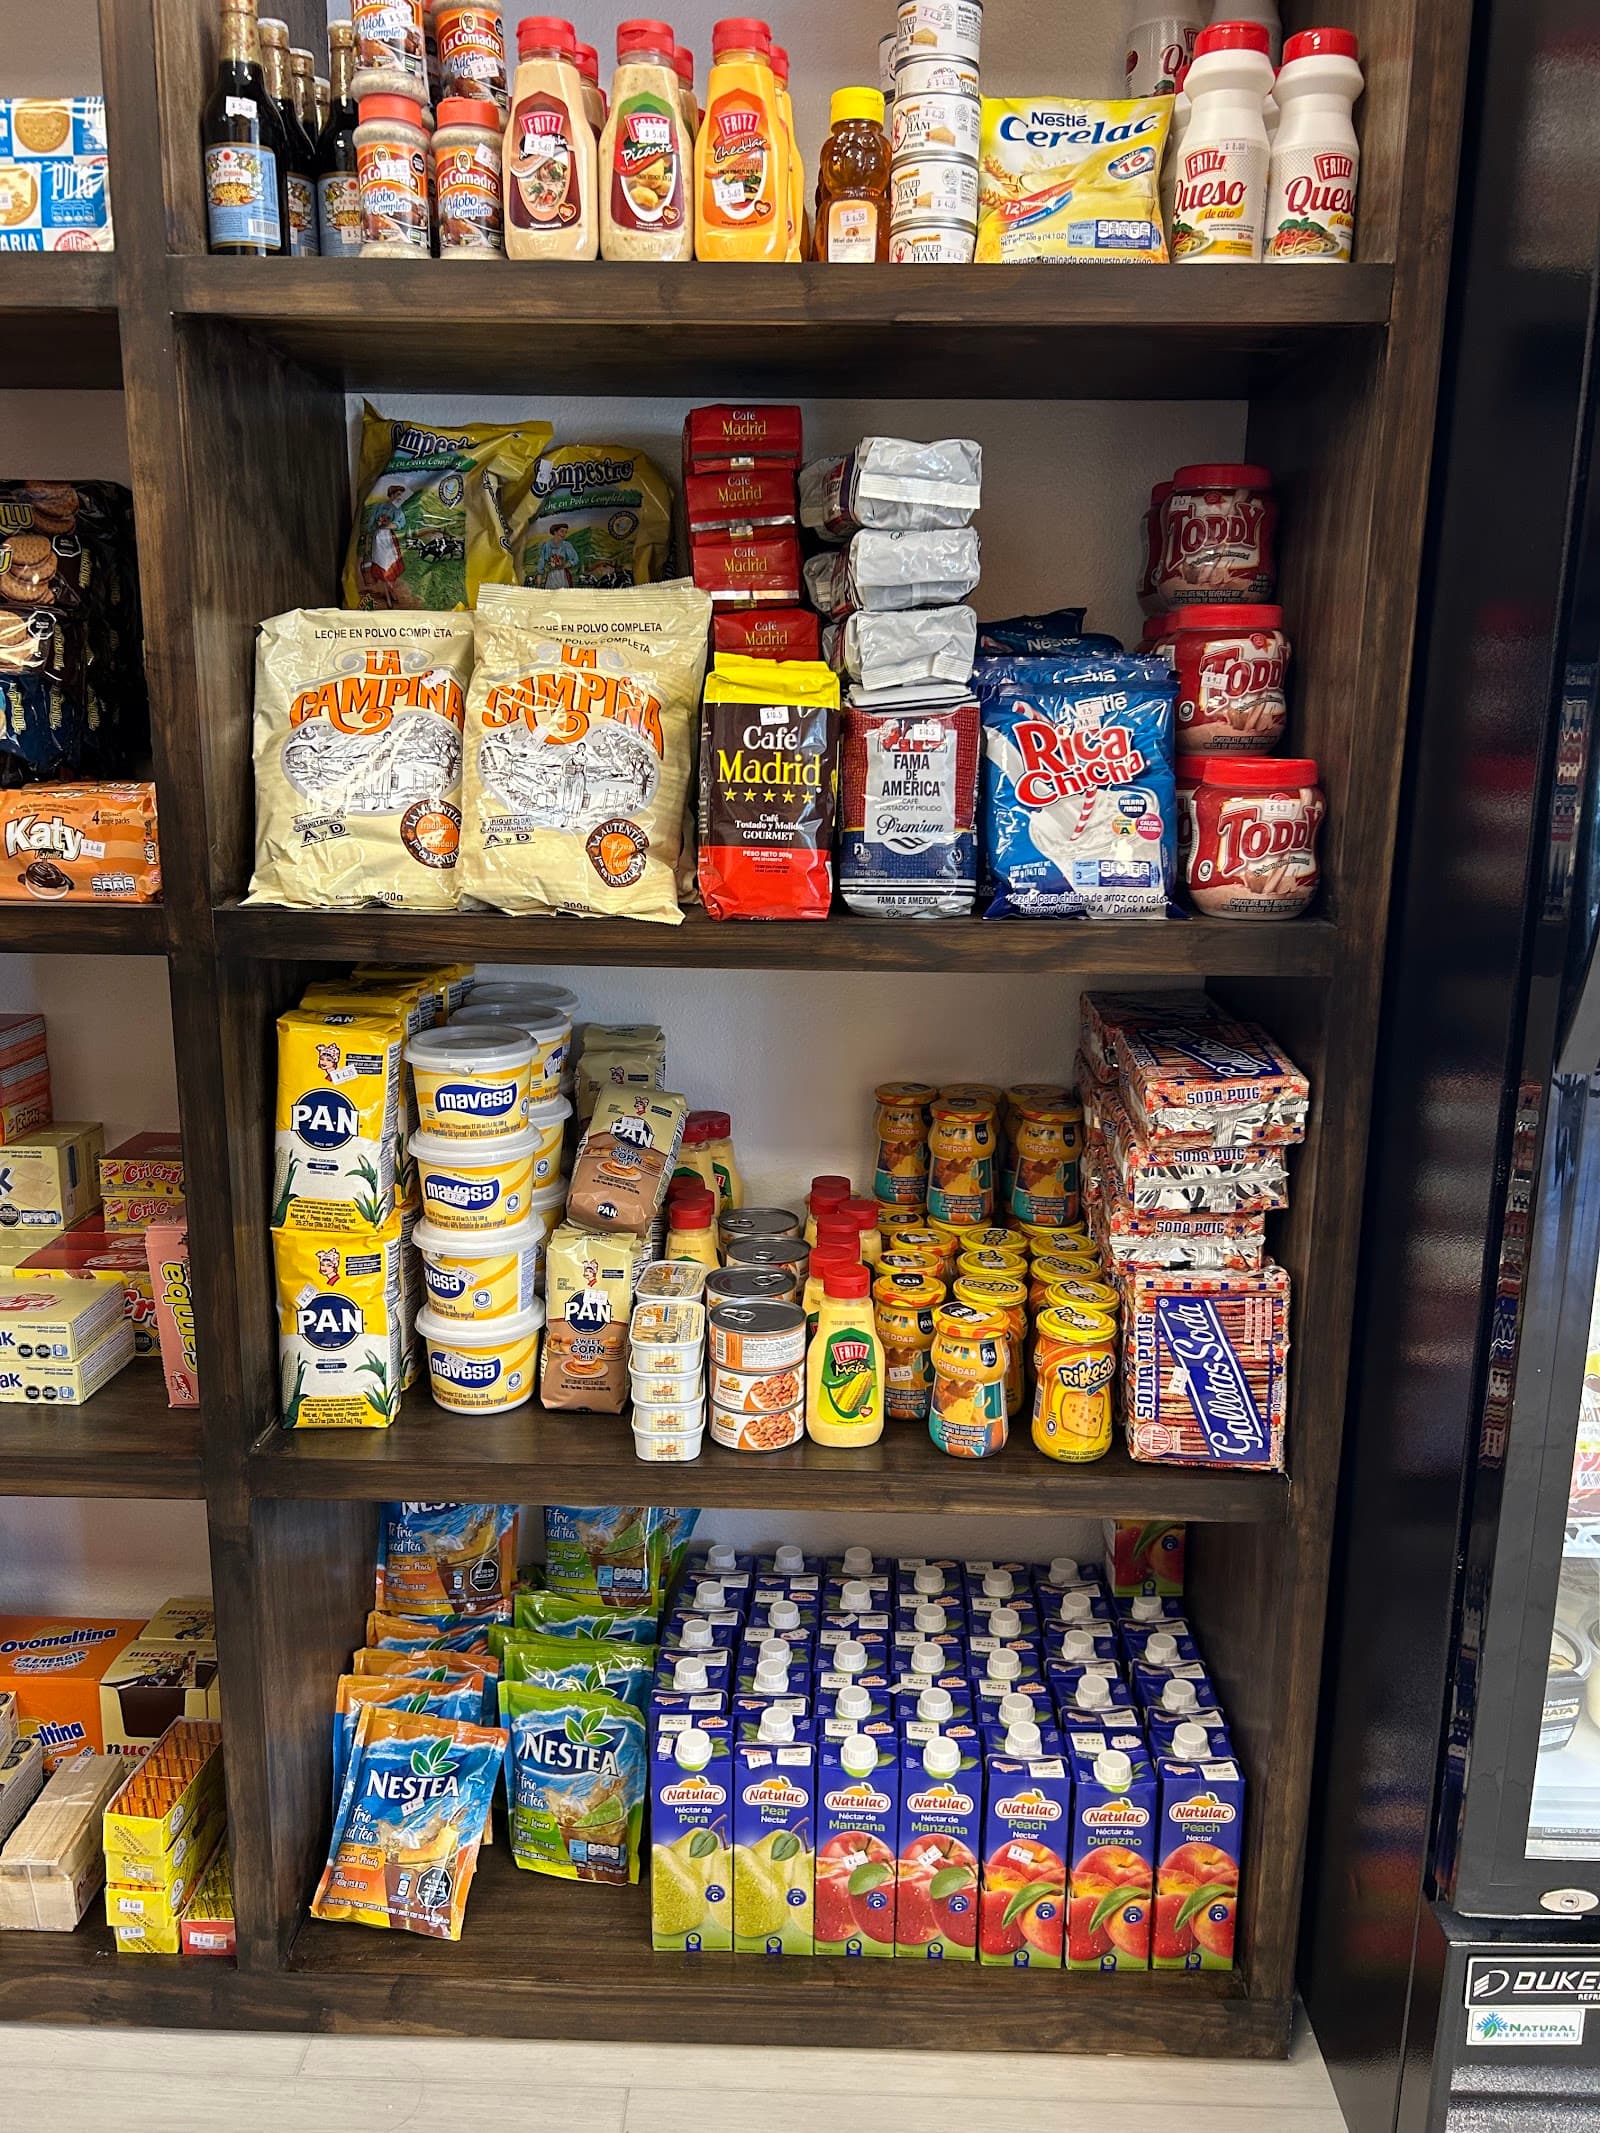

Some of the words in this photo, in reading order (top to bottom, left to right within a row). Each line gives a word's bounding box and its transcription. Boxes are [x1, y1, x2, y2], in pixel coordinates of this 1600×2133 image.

[444, 38, 454, 53] La
[455, 32, 500, 53] Comadre
[528, 114, 559, 134] FRITZ
[724, 113, 754, 135] FRITZ
[1031, 112, 1088, 127] Nestlé
[1000, 115, 1157, 148] Cerelac
[622, 143, 674, 167] Picante
[715, 137, 767, 163] Cheddar
[1190, 152, 1224, 176] FRITZ
[1322, 158, 1351, 178] FRITZ
[439, 175, 448, 192] La
[449, 170, 497, 193] Comadre
[365, 187, 396, 209] Adobo
[446, 192, 477, 211] Adobo
[373, 202, 410, 215] Completo
[454, 206, 492, 219] Completo
[1005, 203, 1019, 217] 12
[1205, 209, 1216, 218] de
[911, 245, 942, 254] DEVILED
[732, 410, 756, 421] Café
[722, 420, 767, 436] Madrid
[727, 476, 750, 487] Café
[718, 487, 763, 502] Madrid
[1167, 503, 1266, 572] TODDY
[734, 547, 757, 558] Café
[724, 557, 768, 572] Madrid
[577, 622, 609, 633] POLVO
[611, 622, 662, 633] COMPLETA
[755, 621, 777, 631] Café
[315, 629, 347, 639] LECHE
[350, 629, 363, 638] EN
[365, 628, 397, 639] POLVO
[745, 630, 788, 645] Madrid
[565, 636, 597, 645] POLVO
[600, 637, 650, 654] COMPLETA
[365, 650, 400, 675] LA
[561, 644, 597, 668] LA
[290, 670, 466, 736] CAMPIÑA
[482, 671, 665, 760] CAMPIÑA
[743, 726, 798, 751] Café
[1013, 721, 1128, 772] Rica
[717, 750, 822, 787] Madrid
[894, 754, 929, 770] FAMA
[905, 770, 918, 781] DE
[1015, 752, 1144, 806] Chicha
[881, 780, 940, 797] AMERICA
[92, 810, 100, 825] 4
[760, 813, 779, 823] Café
[735, 820, 766, 829] Tostado
[876, 814, 944, 836] Premium
[1120, 827, 1130, 835] A
[5, 813, 86, 862] Katy
[304, 830, 317, 843] A
[330, 823, 345, 835] D
[486, 834, 501, 846] A
[516, 833, 530, 842] D
[743, 830, 794, 841] GOURMET
[1217, 806, 1323, 877] TODDY
[742, 850, 759, 858] PESO
[760, 850, 778, 859] NETO
[877, 896, 896, 905] FAMA
[897, 896, 907, 905] DE
[907, 896, 938, 905] AMERICA
[1038, 895, 1057, 905] para
[1059, 893, 1090, 903] chicha
[1091, 893, 1102, 902] de
[1103, 895, 1126, 903] arroz
[1128, 895, 1145, 903] con
[1114, 904, 1137, 913] Drink
[439, 1089, 514, 1110] mavesa
[1186, 1090, 1223, 1105] SODA
[1227, 1087, 1261, 1100] PUIG
[887, 1127, 920, 1136] CHEDDAR
[937, 1144, 973, 1154] CHEDDAR
[1025, 1144, 1060, 1154] CHEDDAR
[1174, 1149, 1209, 1162] SODA
[1214, 1149, 1245, 1162] PUIG
[610, 1151, 643, 1165] CORN
[124, 1163, 150, 1184] Cri
[152, 1163, 183, 1184] Cri
[129, 1201, 155, 1221] Cri
[596, 1206, 617, 1218] PAN
[1157, 1221, 1190, 1233] SODA
[1194, 1222, 1225, 1233] PUIG
[950, 1306, 976, 1318] PAN
[920, 1319, 932, 1329] PAN
[877, 1327, 915, 1344] CHEDDAR
[1136, 1313, 1155, 1362] PUIG
[1167, 1303, 1224, 1362] Soda
[570, 1344, 605, 1354] CORN
[839, 1344, 865, 1362] FRITZ
[982, 1350, 996, 1360] PAN
[431, 1357, 496, 1380] mavesa
[835, 1361, 867, 1377] Maíz
[937, 1360, 977, 1377] CHEDDAR
[1136, 1372, 1155, 1419] SODA
[1202, 1360, 1264, 1456] Galletas
[563, 1529, 577, 1539] tea
[403, 1543, 422, 1553] tea
[0, 1628, 117, 1654] Ovomaltina
[525, 1732, 620, 1777] NESTEA
[367, 1768, 460, 1799] NESTEA
[521, 1778, 537, 1791] frío
[667, 1789, 720, 1801] Natulac
[749, 1790, 801, 1803] Natulac
[529, 1796, 545, 1809] tea
[831, 1796, 885, 1809] Natulac
[914, 1797, 967, 1811] Natulac
[352, 1804, 372, 1823] frío
[675, 1806, 701, 1814] Néctar
[761, 1806, 790, 1817] Pear
[838, 1812, 865, 1821] Néctar
[1001, 1803, 1056, 1817] Natulac
[1175, 1806, 1230, 1819] Natulac
[679, 1814, 708, 1824] Pera
[761, 1815, 788, 1824] Nectar
[921, 1814, 947, 1823] Néctar
[948, 1815, 959, 1823] de
[1008, 1819, 1047, 1831] Peach
[1088, 1812, 1143, 1825] Natulac
[829, 1820, 886, 1832] Manzana
[911, 1822, 968, 1835] Manzana
[1096, 1827, 1121, 1836] Néctar
[1181, 1822, 1220, 1833] Peach
[358, 1829, 374, 1843] tea
[1012, 1831, 1039, 1840] Nectar
[1087, 1836, 1142, 1846] Durazno
[1186, 1834, 1212, 1843] Nectar
[359, 1854, 378, 1868] Peach
[711, 1893, 719, 1901] C
[1042, 1910, 1050, 1918] C
[1215, 1912, 1222, 1920] C
[1513, 1971, 1600, 1990] DUKE
[1510, 2024, 1576, 2032] NATURAL
